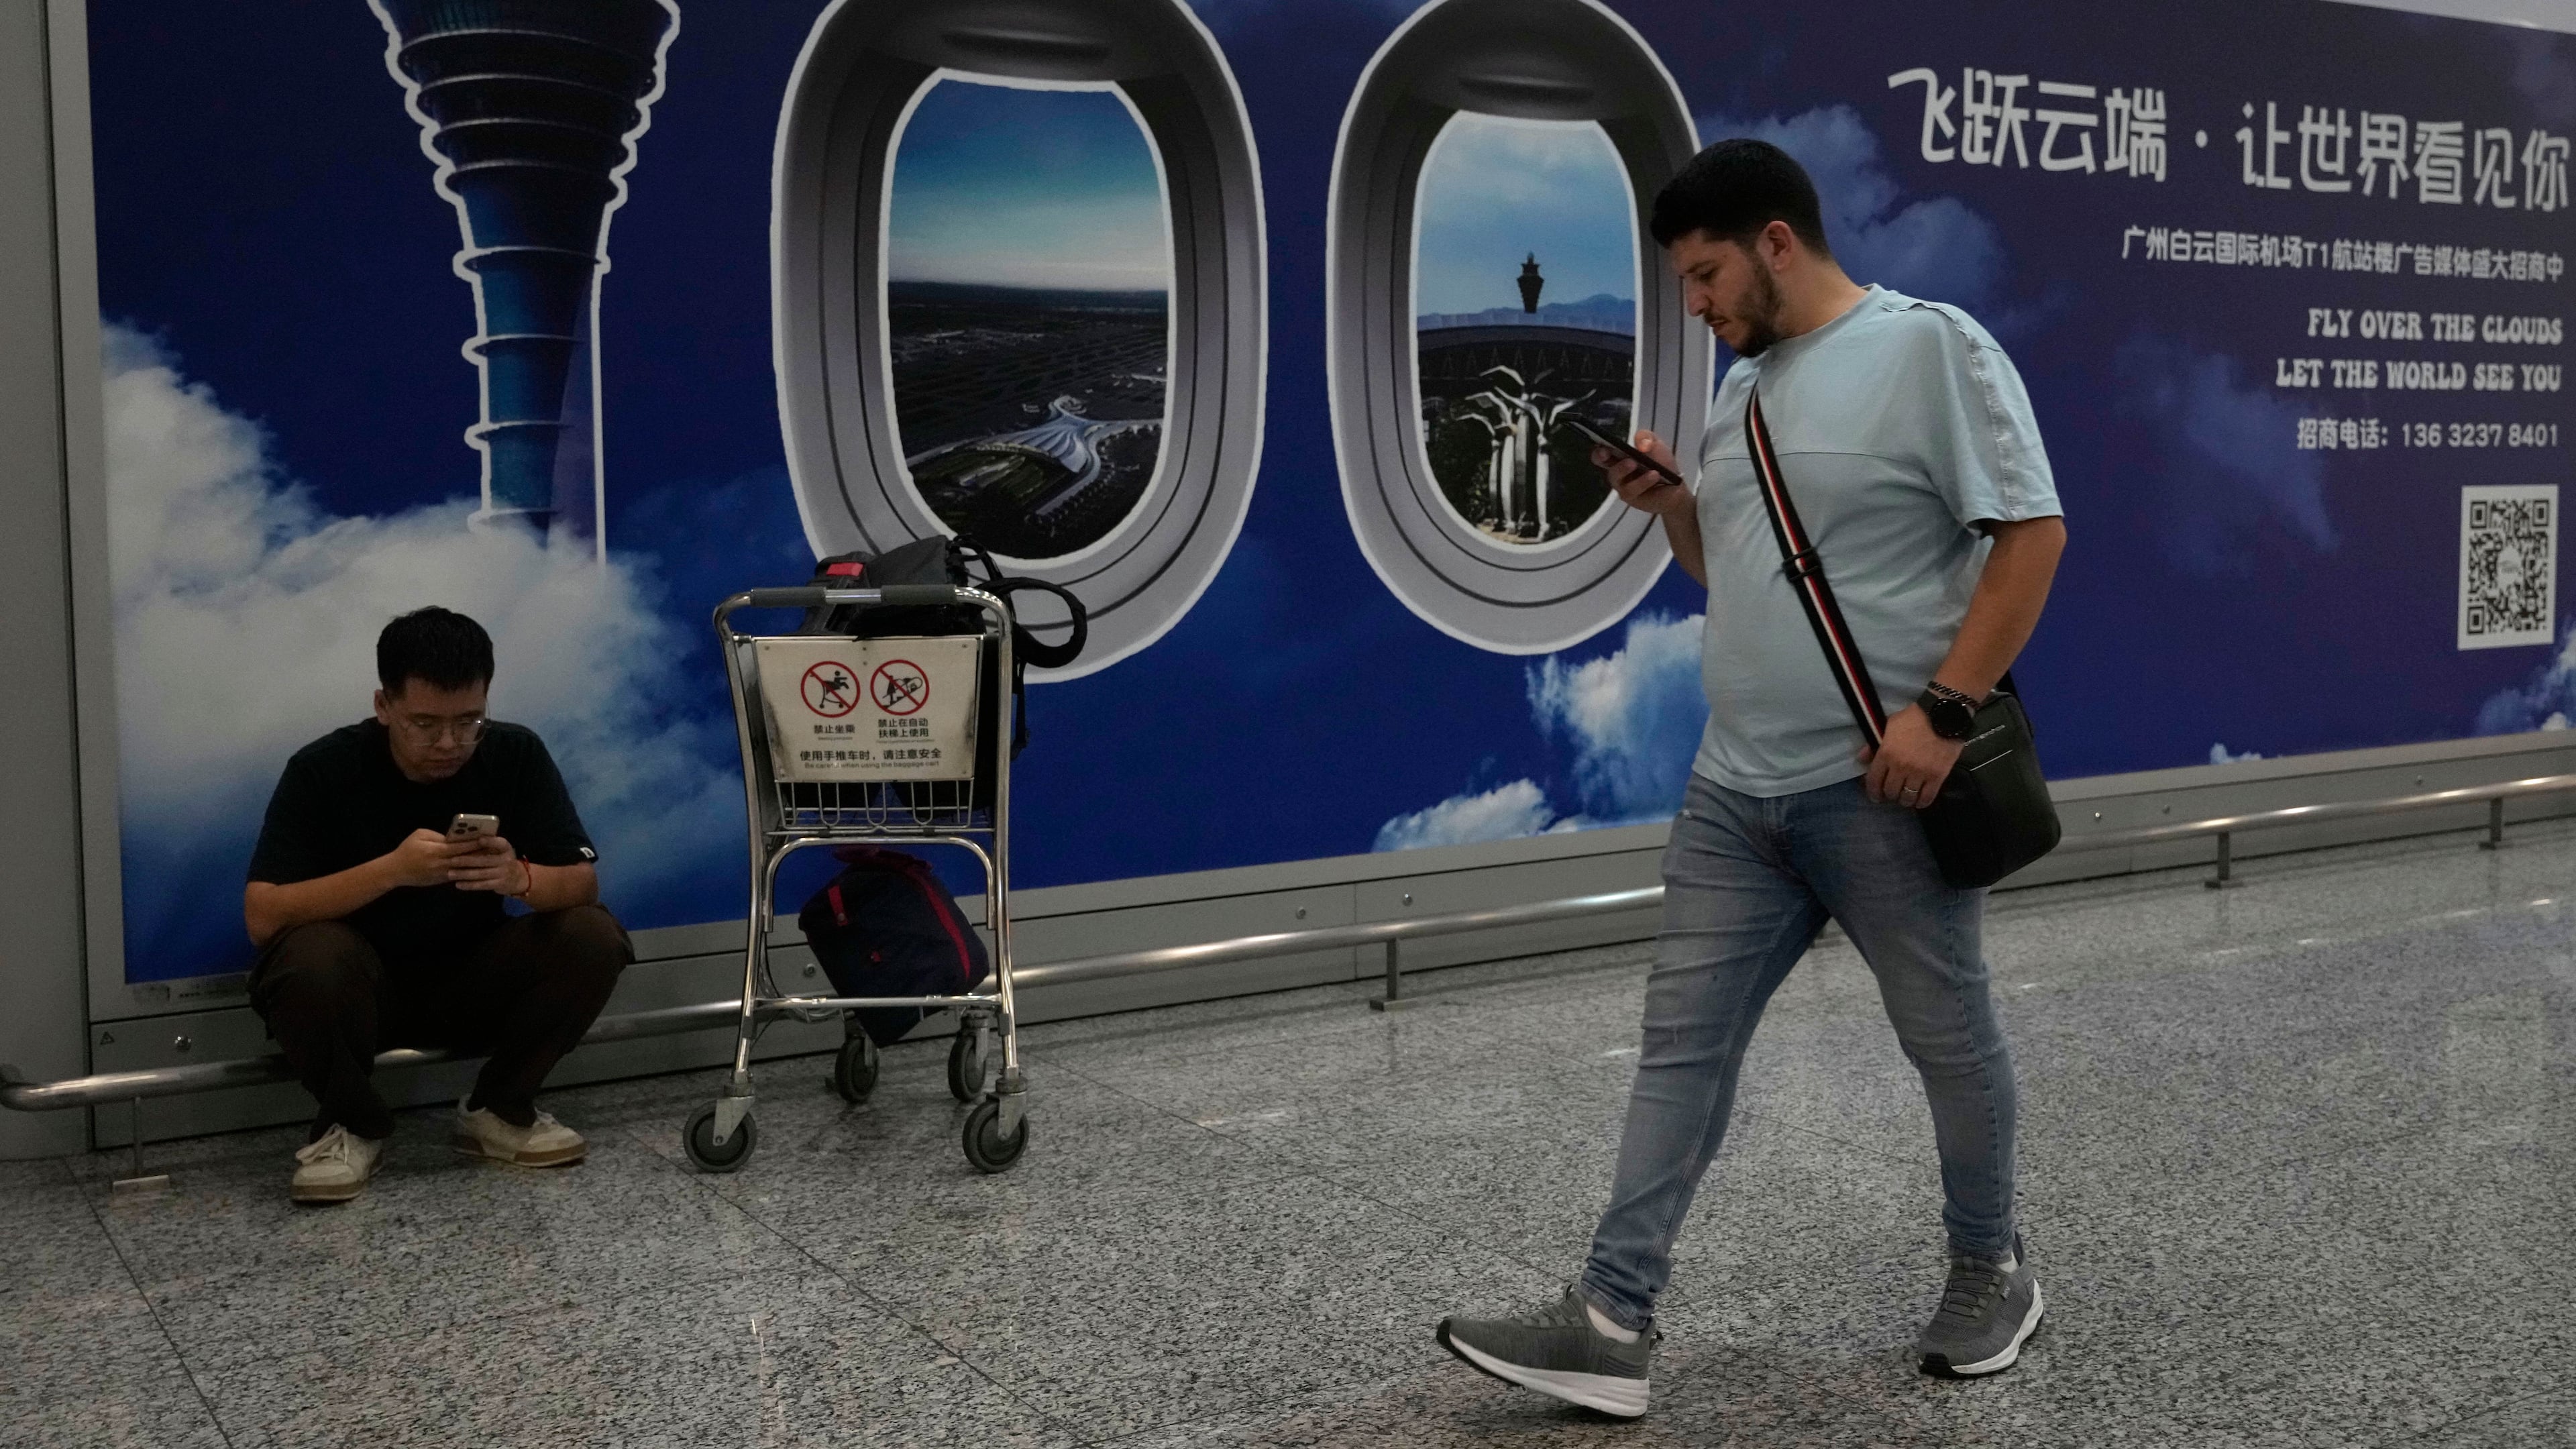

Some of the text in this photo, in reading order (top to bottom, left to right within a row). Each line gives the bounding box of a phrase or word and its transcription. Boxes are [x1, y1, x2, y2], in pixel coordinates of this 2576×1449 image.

[2307, 307, 2564, 345] FLY OVER THE CLOUDS
[2275, 357, 2562, 392] LET THE WORLD SEE YOU
[2402, 423, 2443, 447] 136
[2448, 423, 2504, 448] 3237
[2508, 422, 2558, 447] 8401
[814, 724, 855, 734] 禁止坐乘
[877, 718, 928, 728] 禁止在自动
[878, 728, 929, 738] 扶梯上使用
